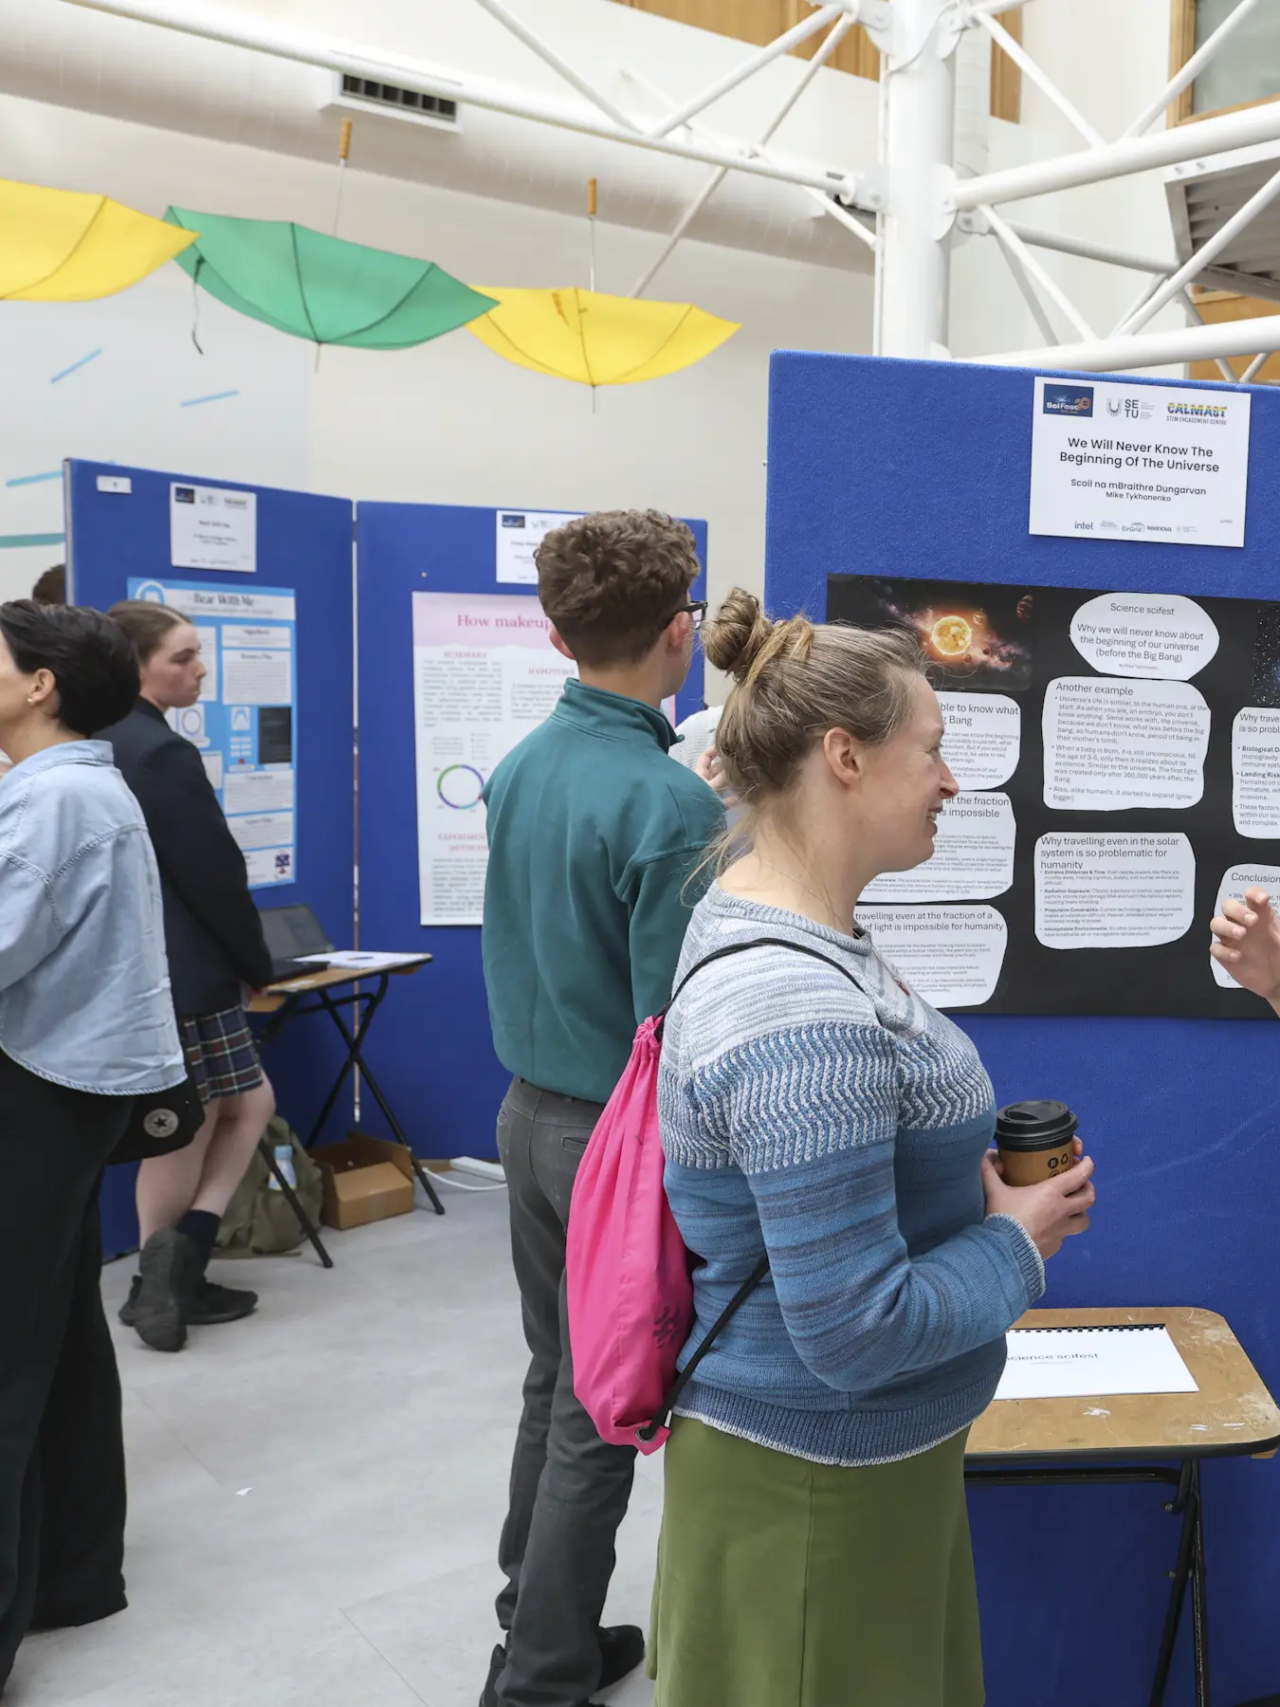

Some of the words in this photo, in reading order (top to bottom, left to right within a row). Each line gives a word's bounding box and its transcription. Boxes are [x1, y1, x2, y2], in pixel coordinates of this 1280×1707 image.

[1124, 399, 1139, 409] SE
[1125, 409, 1139, 419] TU
[1167, 402, 1228, 418] CALMAST
[1068, 438, 1087, 449] We
[1090, 439, 1113, 450] Will
[1116, 441, 1152, 452] Never
[1155, 444, 1188, 455] Know
[1192, 446, 1213, 457] The
[1060, 451, 1122, 468] Beginning
[1126, 456, 1140, 467] Of
[1142, 457, 1164, 469] The
[1167, 459, 1219, 473] Universe
[1071, 479, 1092, 487] Scoil
[1156, 485, 1206, 495] Dungarvan
[1074, 521, 1094, 530] intel
[1111, 603, 1144, 613] Science
[1147, 606, 1174, 615] scifest
[457, 615, 488, 627] How
[495, 615, 553, 630] makeup
[1077, 624, 1096, 633] Why
[1113, 626, 1128, 635] will
[1155, 629, 1177, 638] know
[1179, 632, 1203, 640] about
[1096, 637, 1136, 648] beginning
[1138, 639, 1146, 647] of
[1164, 642, 1199, 651] universe
[1096, 649, 1126, 658] (before
[1128, 650, 1142, 658] the
[1144, 652, 1156, 661] Big
[1158, 653, 1182, 662] Bang)
[1056, 682, 1092, 693] Another
[1095, 685, 1133, 696] example
[957, 704, 966, 712] to
[968, 705, 993, 714] know
[996, 706, 1018, 715] what
[949, 716, 972, 727] Bang
[1240, 713, 1257, 723] Why
[957, 797, 972, 805] the
[974, 797, 1009, 806] fraction
[949, 809, 999, 818] impossible
[1041, 836, 1062, 847] Why
[1064, 837, 1105, 847] travelling
[1130, 837, 1138, 845] in
[1140, 837, 1155, 846] the
[1157, 837, 1179, 845] solar
[1041, 850, 1074, 859] system
[1076, 849, 1084, 857] is
[1099, 848, 1153, 859] problematic
[1155, 848, 1167, 857] for
[1041, 861, 1083, 869] humanity
[1231, 872, 1280, 883] Conclusion
[855, 912, 893, 921] travelling
[874, 923, 893, 932] light
[903, 922, 950, 932] impossible
[951, 922, 963, 930] for
[965, 923, 1004, 932] humanity
